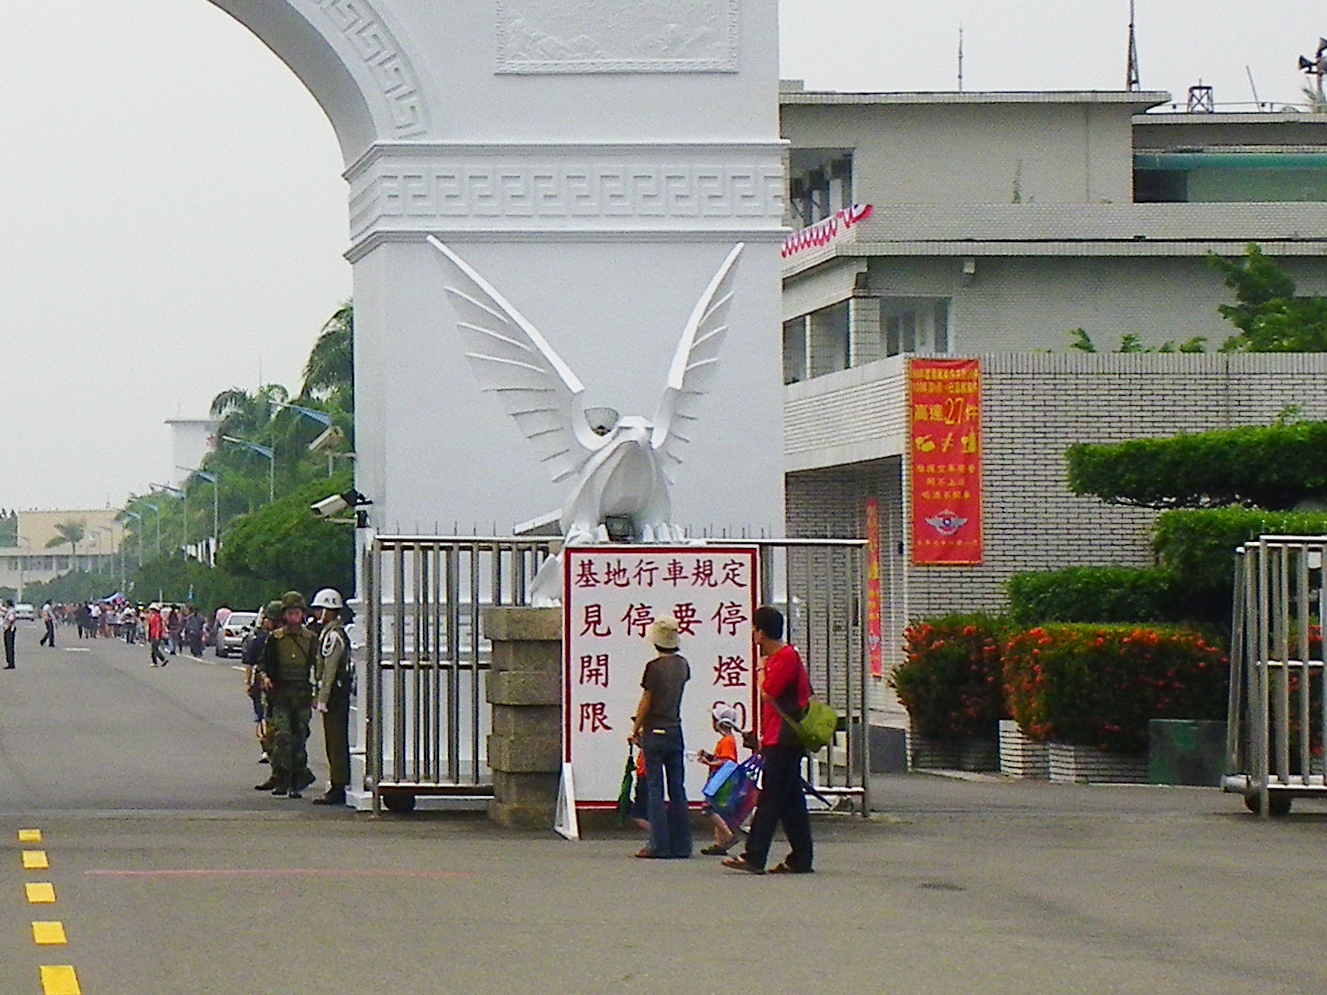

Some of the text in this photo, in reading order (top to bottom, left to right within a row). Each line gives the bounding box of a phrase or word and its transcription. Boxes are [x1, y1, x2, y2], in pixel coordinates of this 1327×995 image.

[575, 558, 748, 588] 基地行車規定
